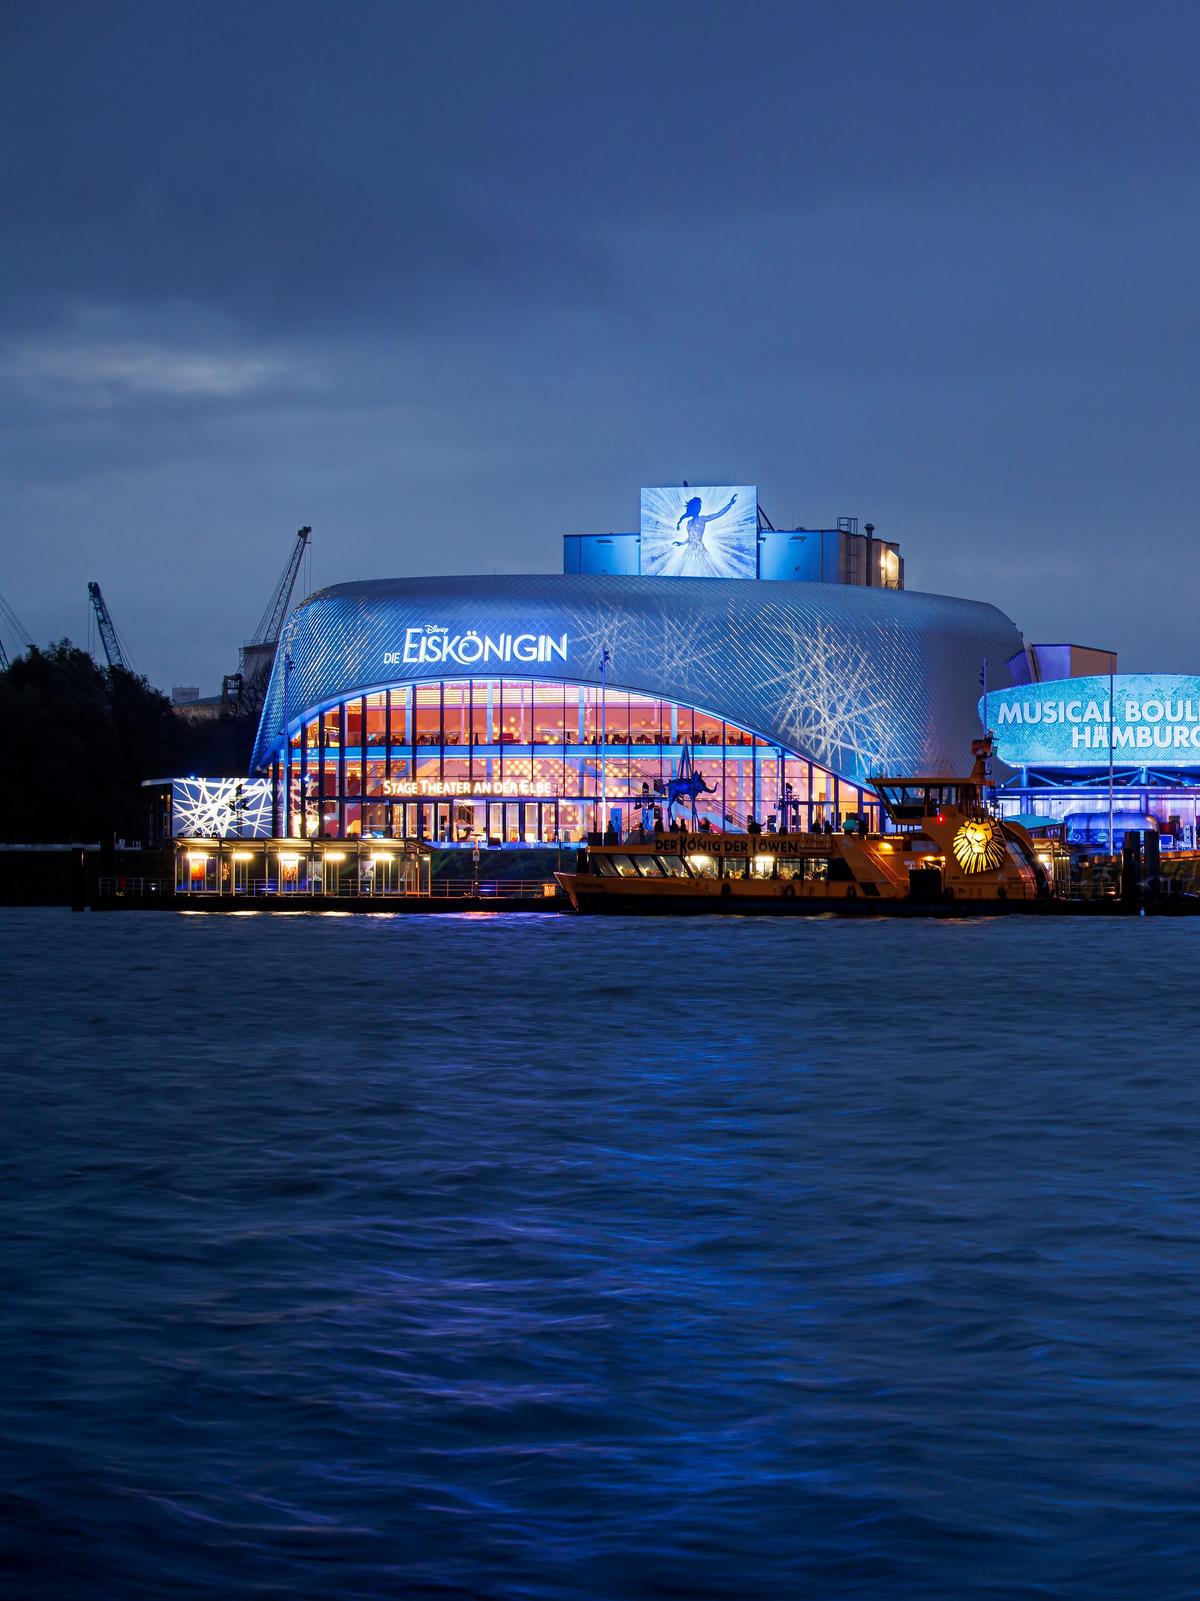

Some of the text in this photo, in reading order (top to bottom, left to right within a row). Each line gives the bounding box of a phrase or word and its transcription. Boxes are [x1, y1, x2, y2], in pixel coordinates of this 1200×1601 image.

[383, 628, 568, 665] DIE EISKÖNIGIN
[998, 700, 1116, 724] MUSICAL
[383, 780, 418, 794] STAGE
[420, 780, 471, 794] THEATER
[655, 840, 677, 850] DER
[680, 836, 720, 853] KÖNIG
[724, 840, 748, 851] DER
